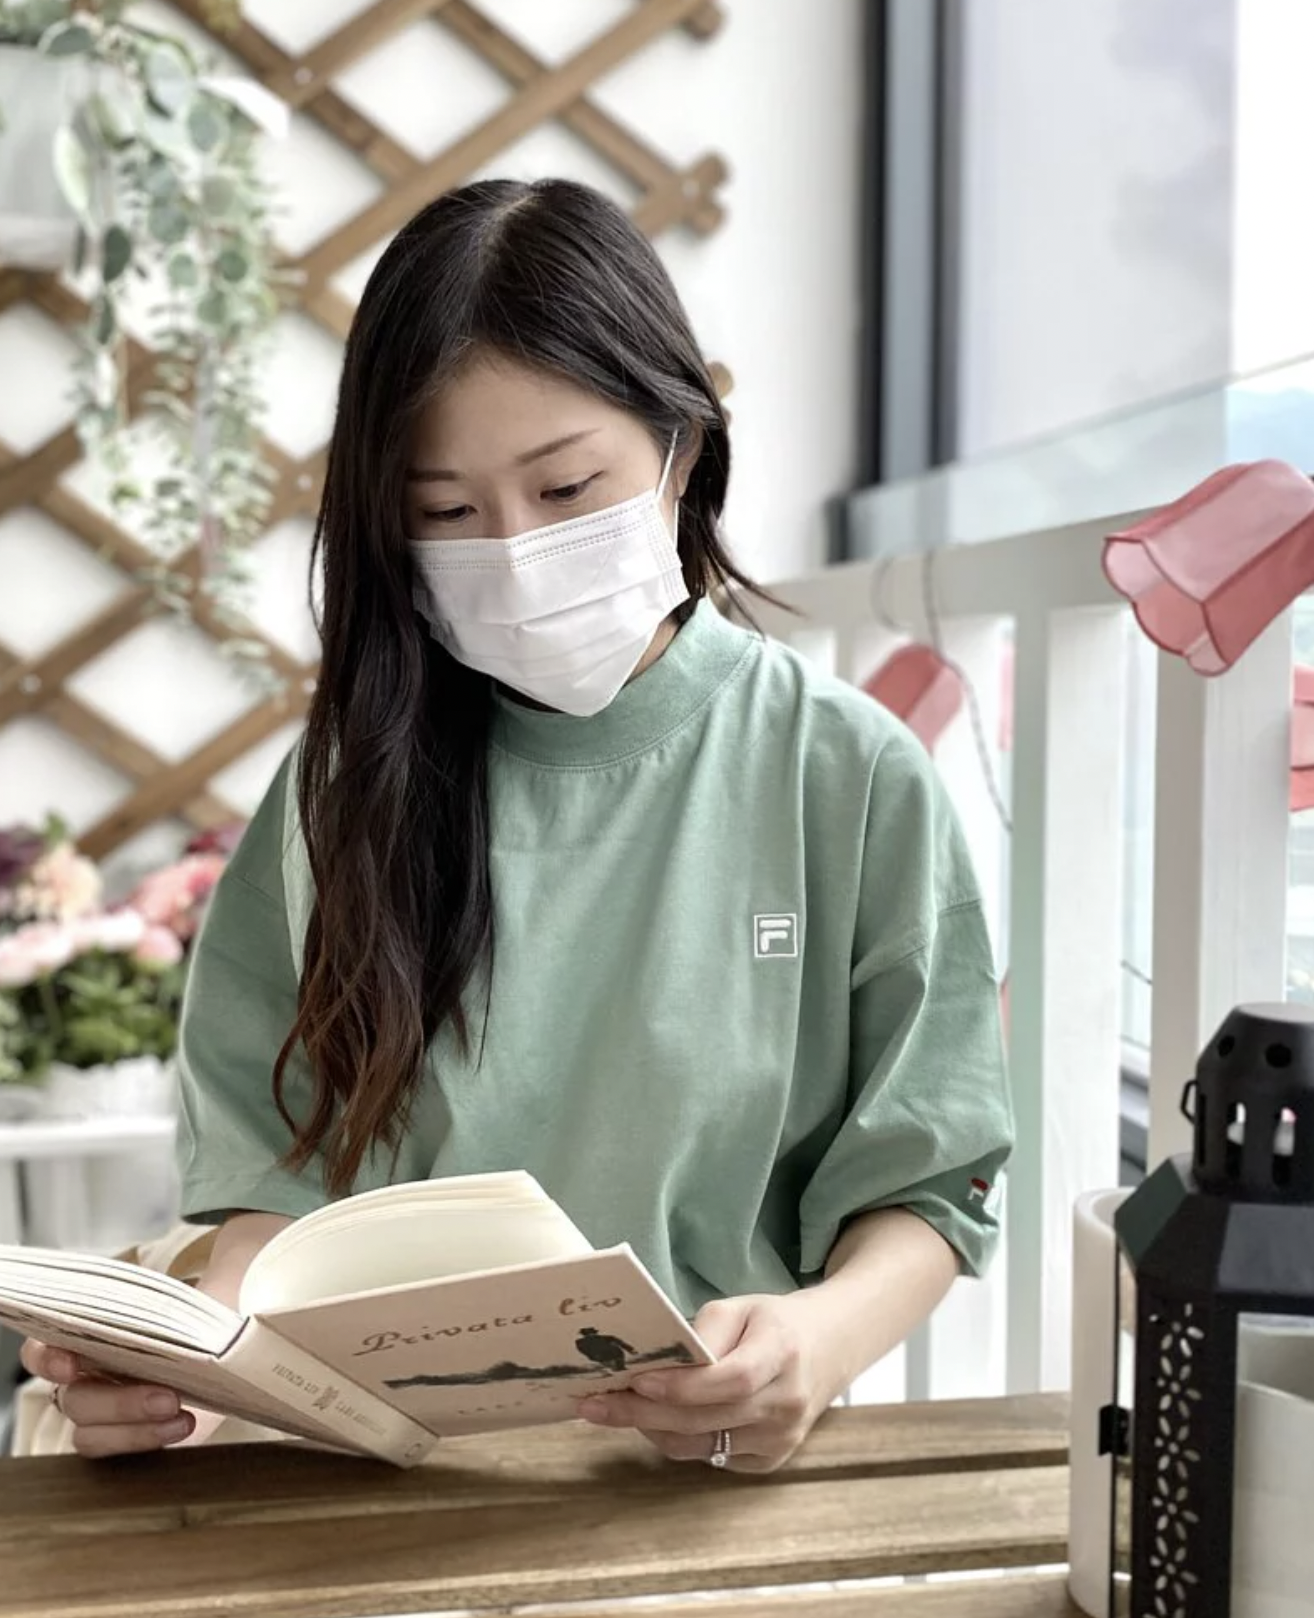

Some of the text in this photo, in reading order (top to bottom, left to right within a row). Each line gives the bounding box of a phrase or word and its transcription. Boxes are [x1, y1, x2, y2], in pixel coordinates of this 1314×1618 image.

[759, 919, 792, 952] F
[352, 1295, 622, 1356] Privata liv
